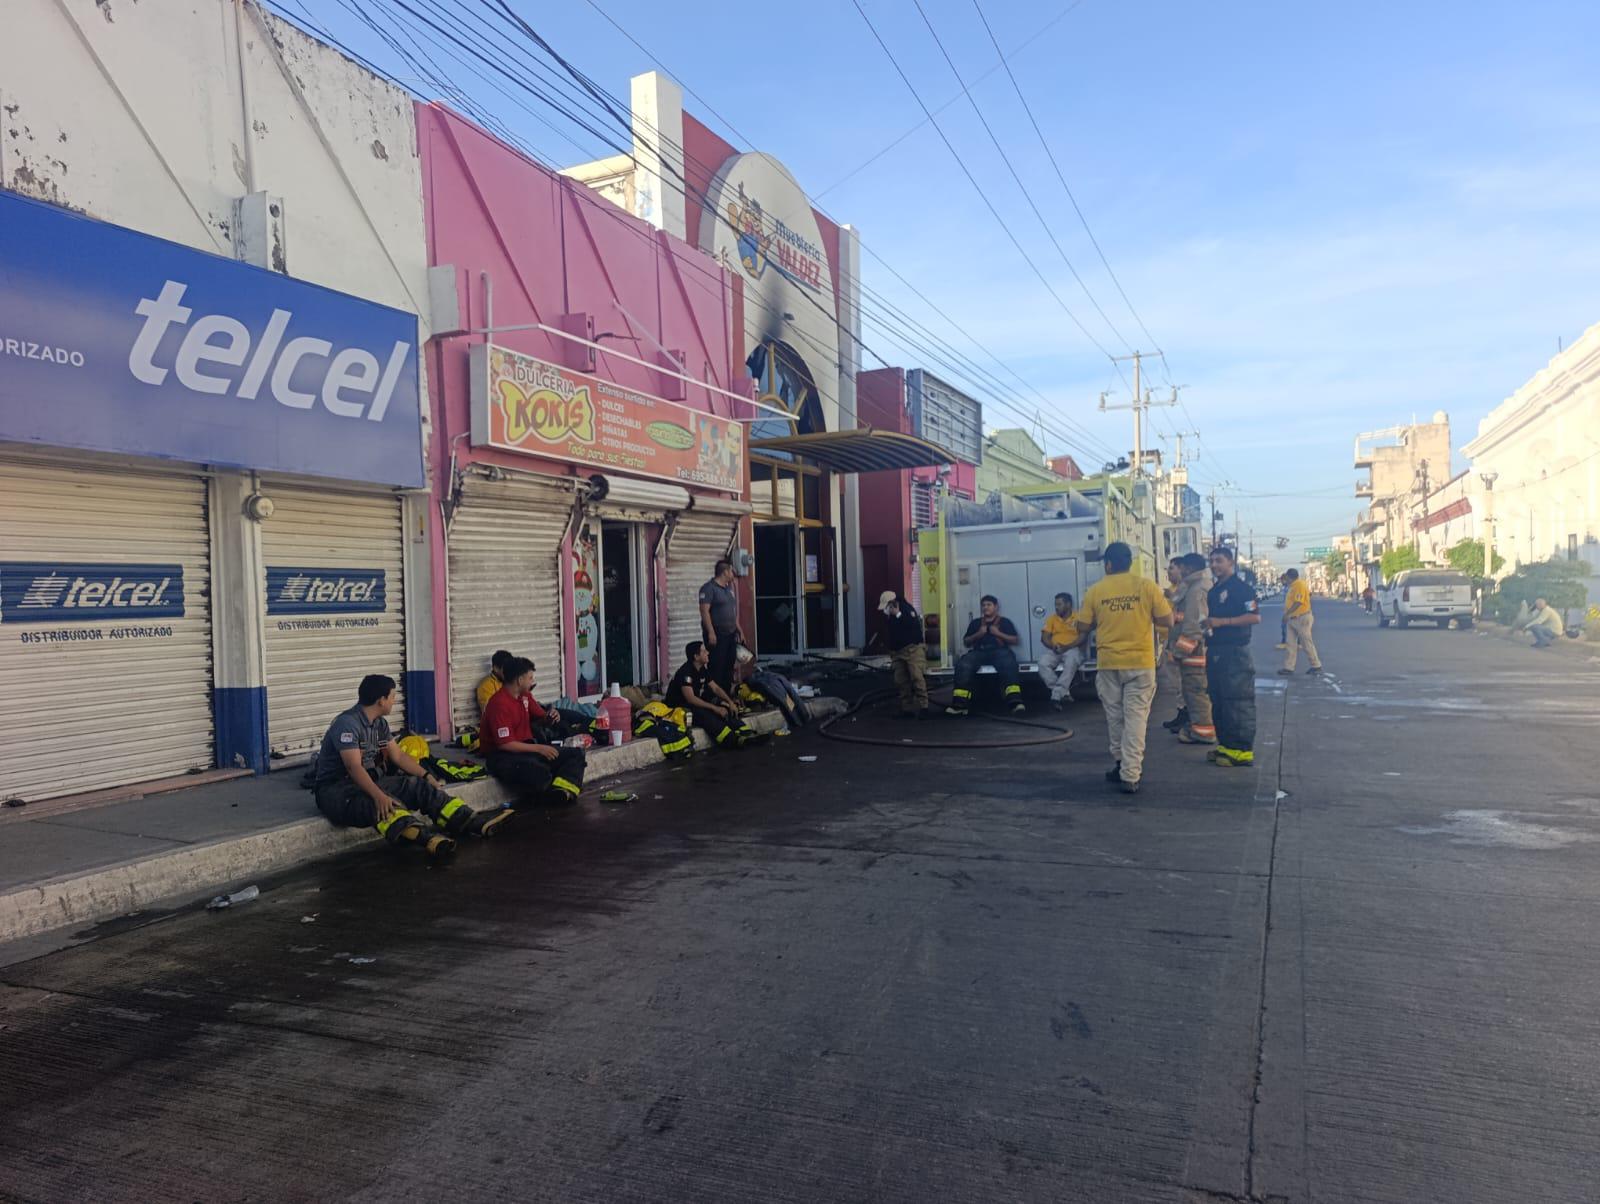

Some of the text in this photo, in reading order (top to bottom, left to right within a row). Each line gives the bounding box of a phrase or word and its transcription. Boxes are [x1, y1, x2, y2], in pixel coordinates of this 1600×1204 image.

[777, 240, 821, 289] VALDEZ
[129, 279, 410, 422] telcel
[517, 365, 576, 396] DULCERIA
[515, 397, 584, 430] KOKIS
[567, 441, 585, 456] Todo
[677, 466, 690, 479] Tel:
[63, 577, 170, 608] telcel
[305, 578, 377, 602] telcel
[1110, 601, 1135, 611] CIVIL
[21, 626, 173, 644] DISTRIBUIDOR AUTORIZADO
